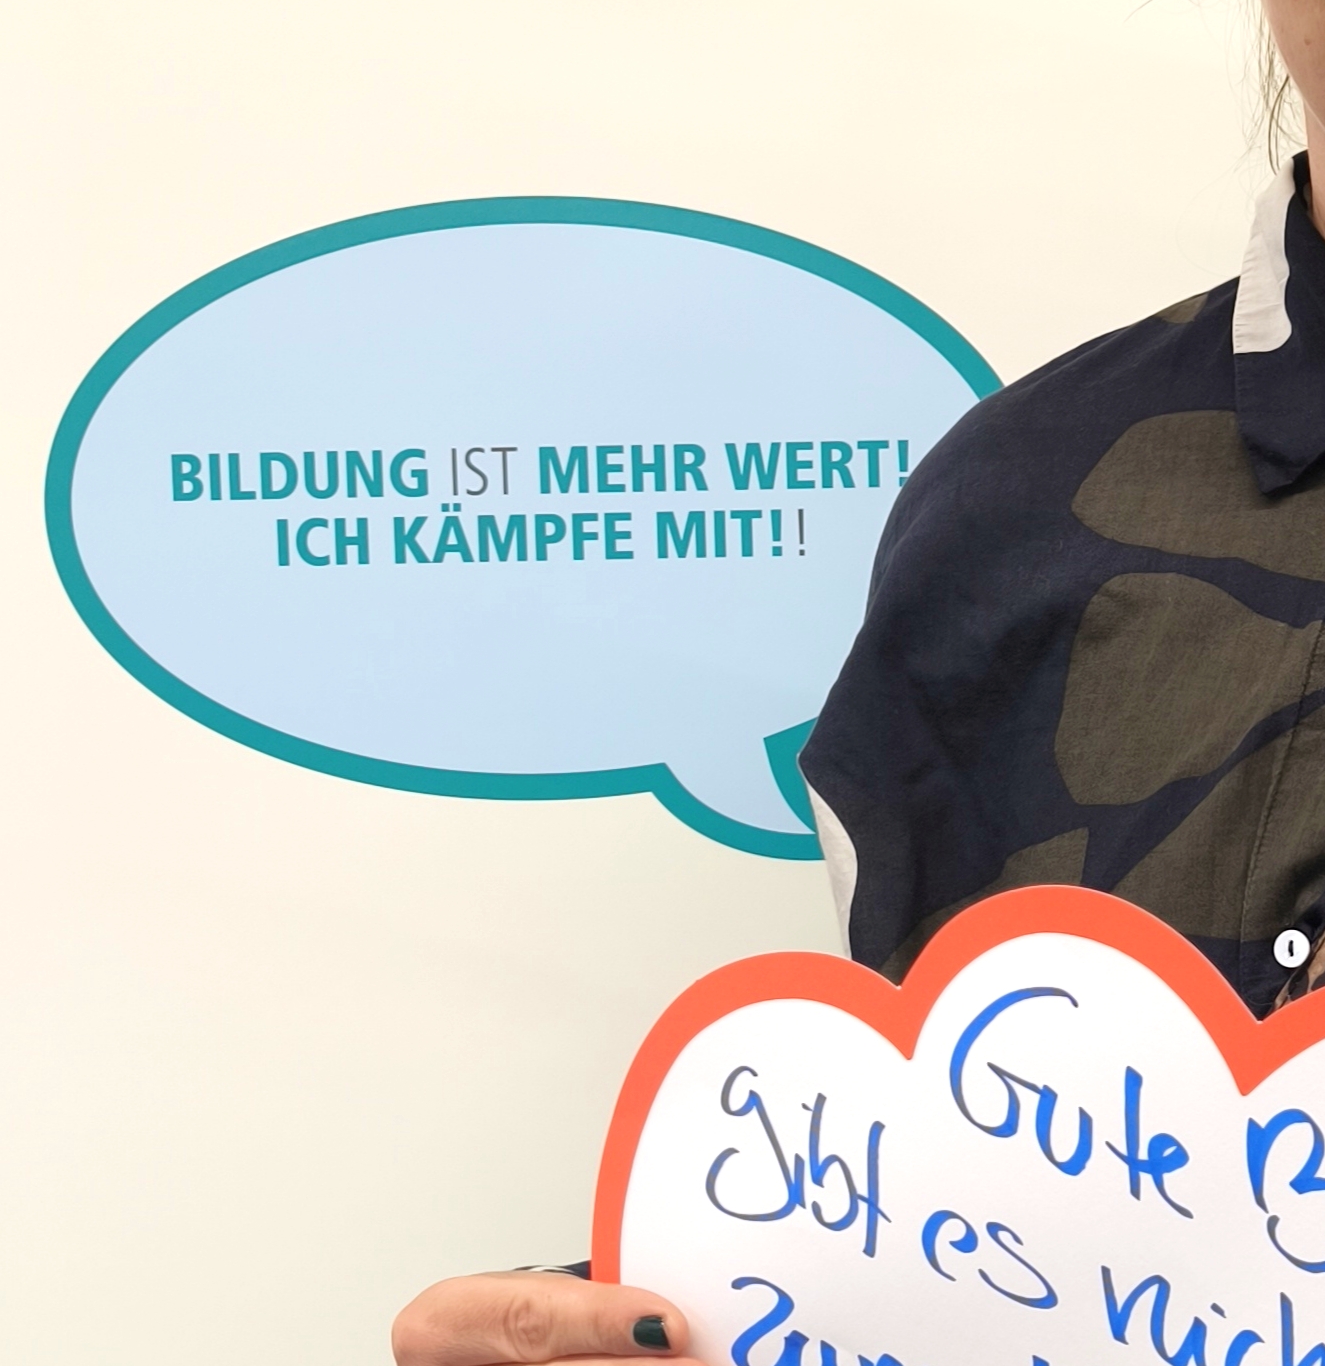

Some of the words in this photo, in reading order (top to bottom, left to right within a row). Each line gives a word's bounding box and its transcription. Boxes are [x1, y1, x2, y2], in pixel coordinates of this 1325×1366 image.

[170, 447, 430, 502] BILDUNG
[449, 445, 519, 497] IST
[538, 443, 709, 495] MEHR
[724, 439, 910, 491] WERT!
[276, 515, 370, 567] ICH
[393, 502, 634, 564] KÄMPFE
[949, 986, 1194, 1220] Gute
[705, 1065, 892, 1259] gibt
[921, 1209, 1059, 1310] es
